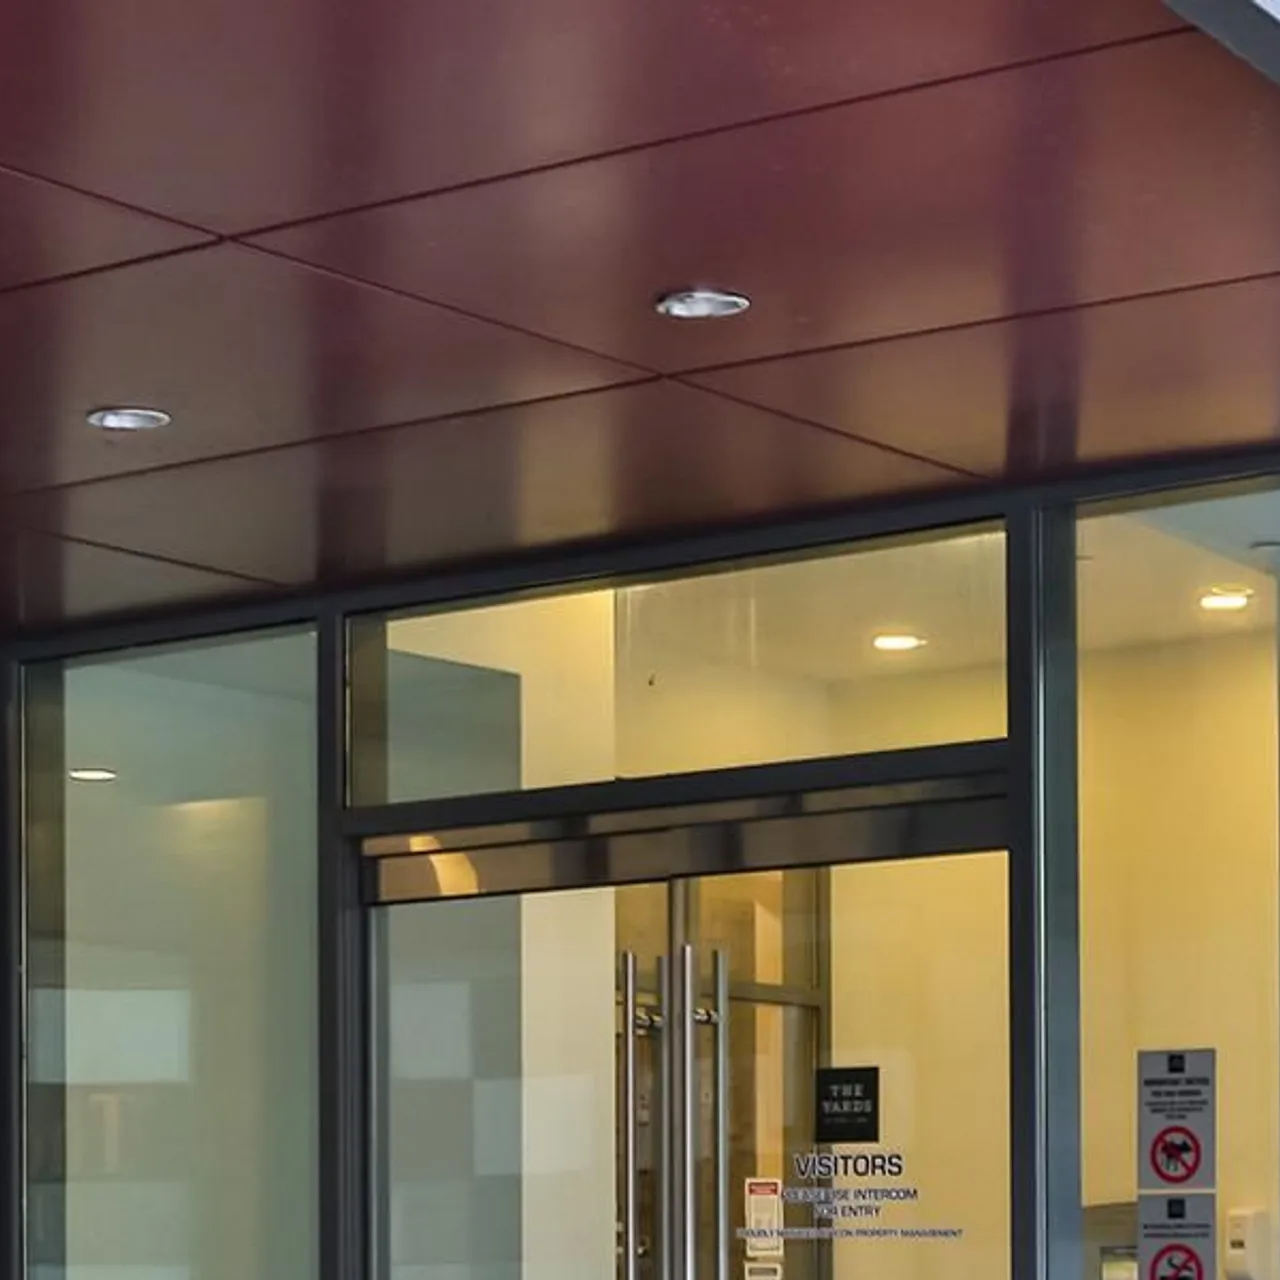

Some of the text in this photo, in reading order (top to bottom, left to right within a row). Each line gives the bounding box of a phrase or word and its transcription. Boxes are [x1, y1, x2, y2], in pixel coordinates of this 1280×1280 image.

[829, 1083, 865, 1097] THE
[822, 1099, 872, 1115] YARDS
[795, 1154, 903, 1177] VISITORS
[853, 1188, 919, 1200] INTERCOM
[841, 1206, 881, 1217] ENTRY
